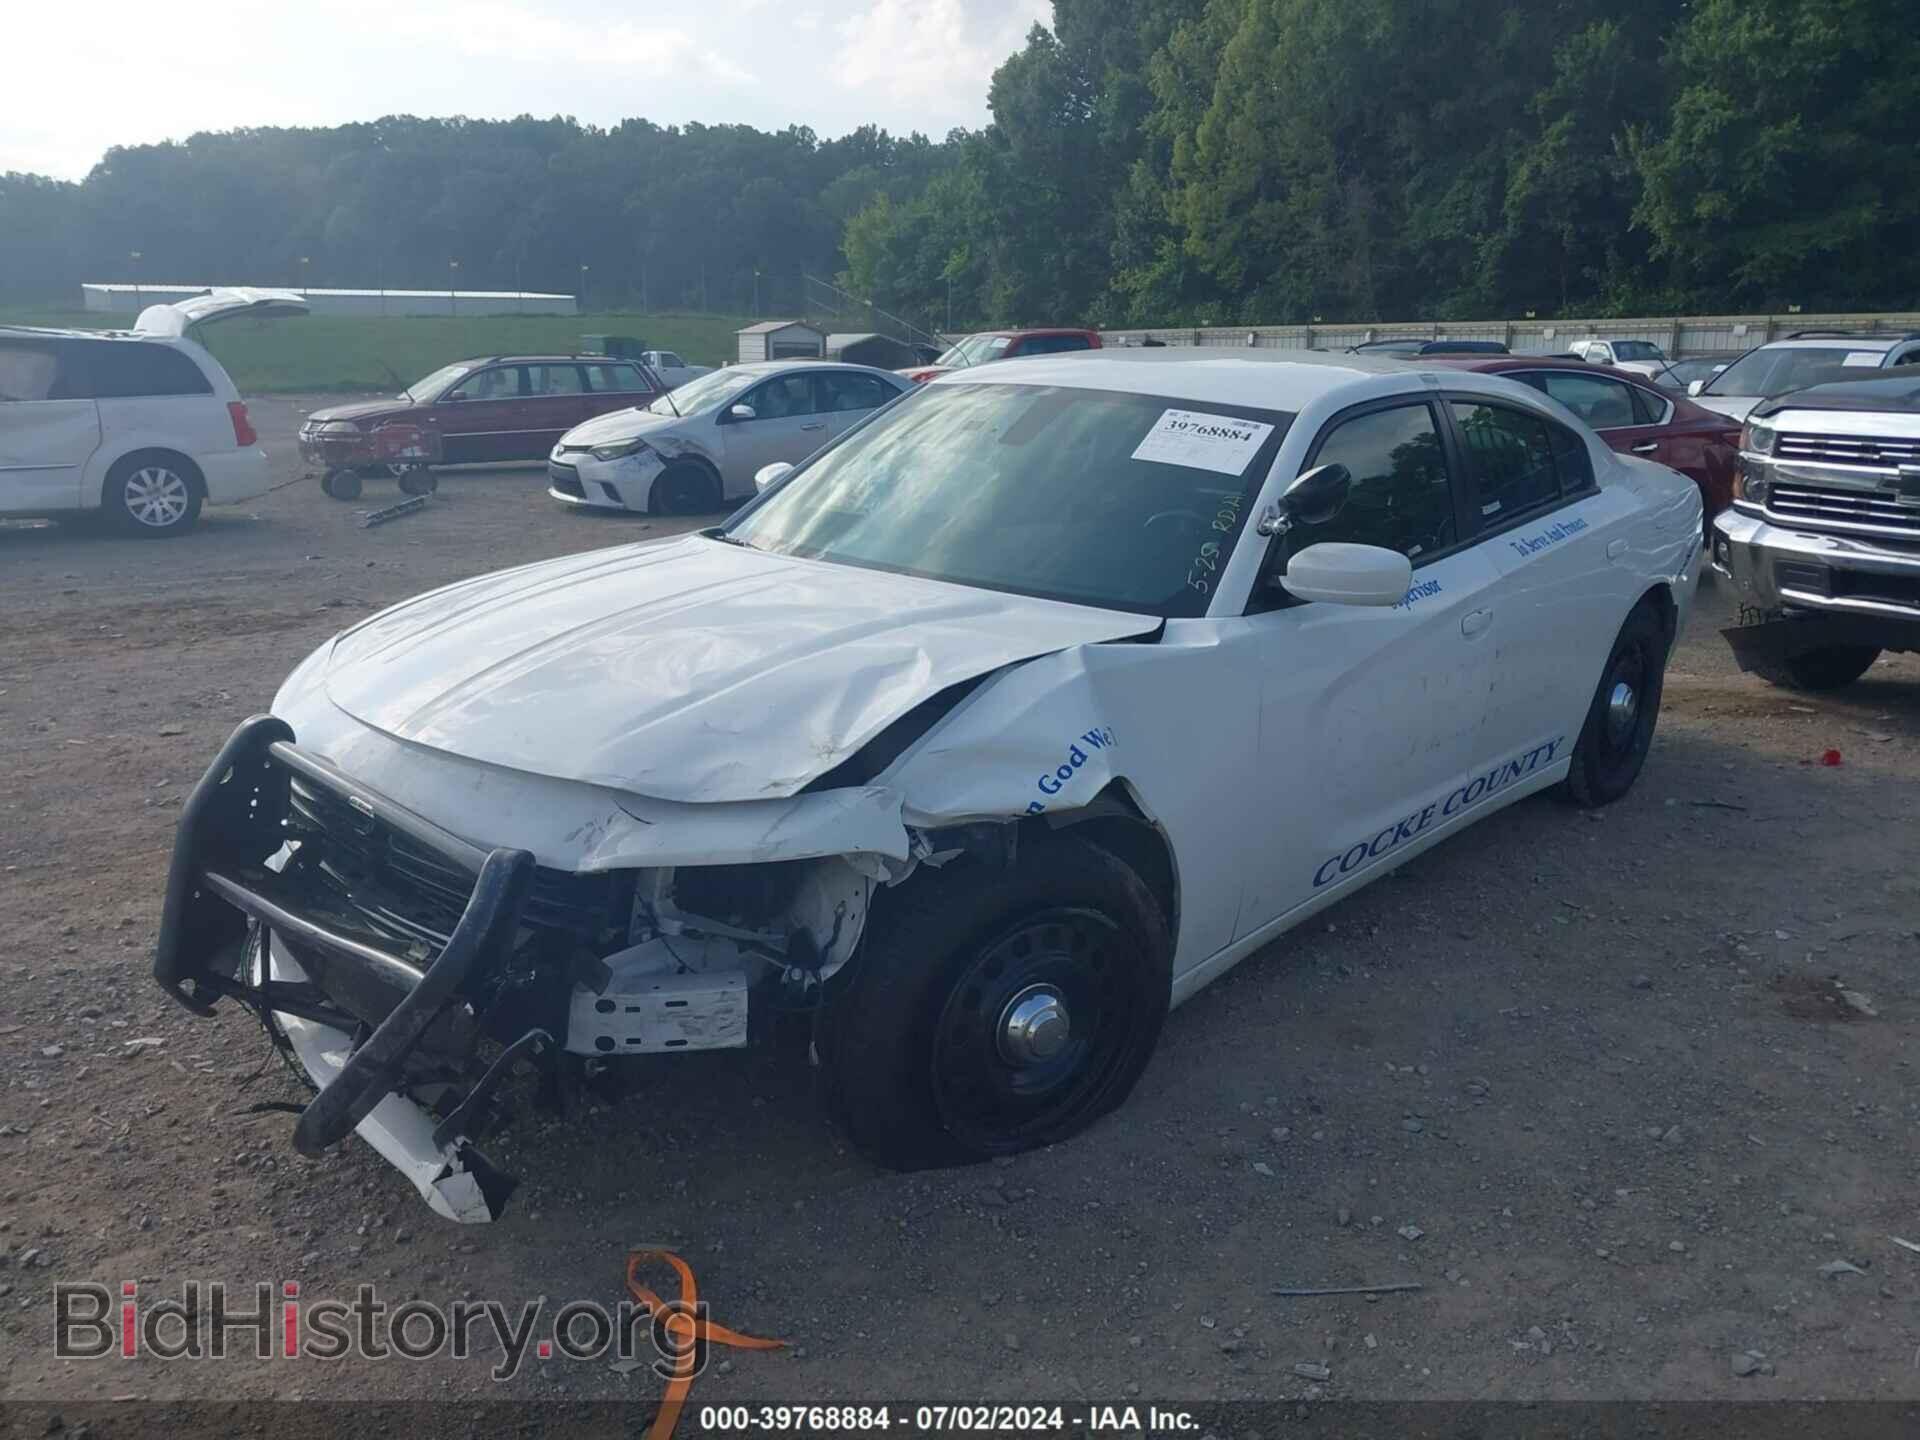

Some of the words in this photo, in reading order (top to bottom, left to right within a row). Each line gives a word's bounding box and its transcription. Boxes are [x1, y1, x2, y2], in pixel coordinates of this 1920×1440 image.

[1164, 419, 1253, 442] 39768884
[1510, 541, 1529, 557] To
[1521, 535, 1550, 552] Serve
[1038, 744, 1088, 794] God
[1080, 727, 1112, 749] We
[1312, 803, 1436, 888] COCKE
[1442, 735, 1565, 815] COUNTY
